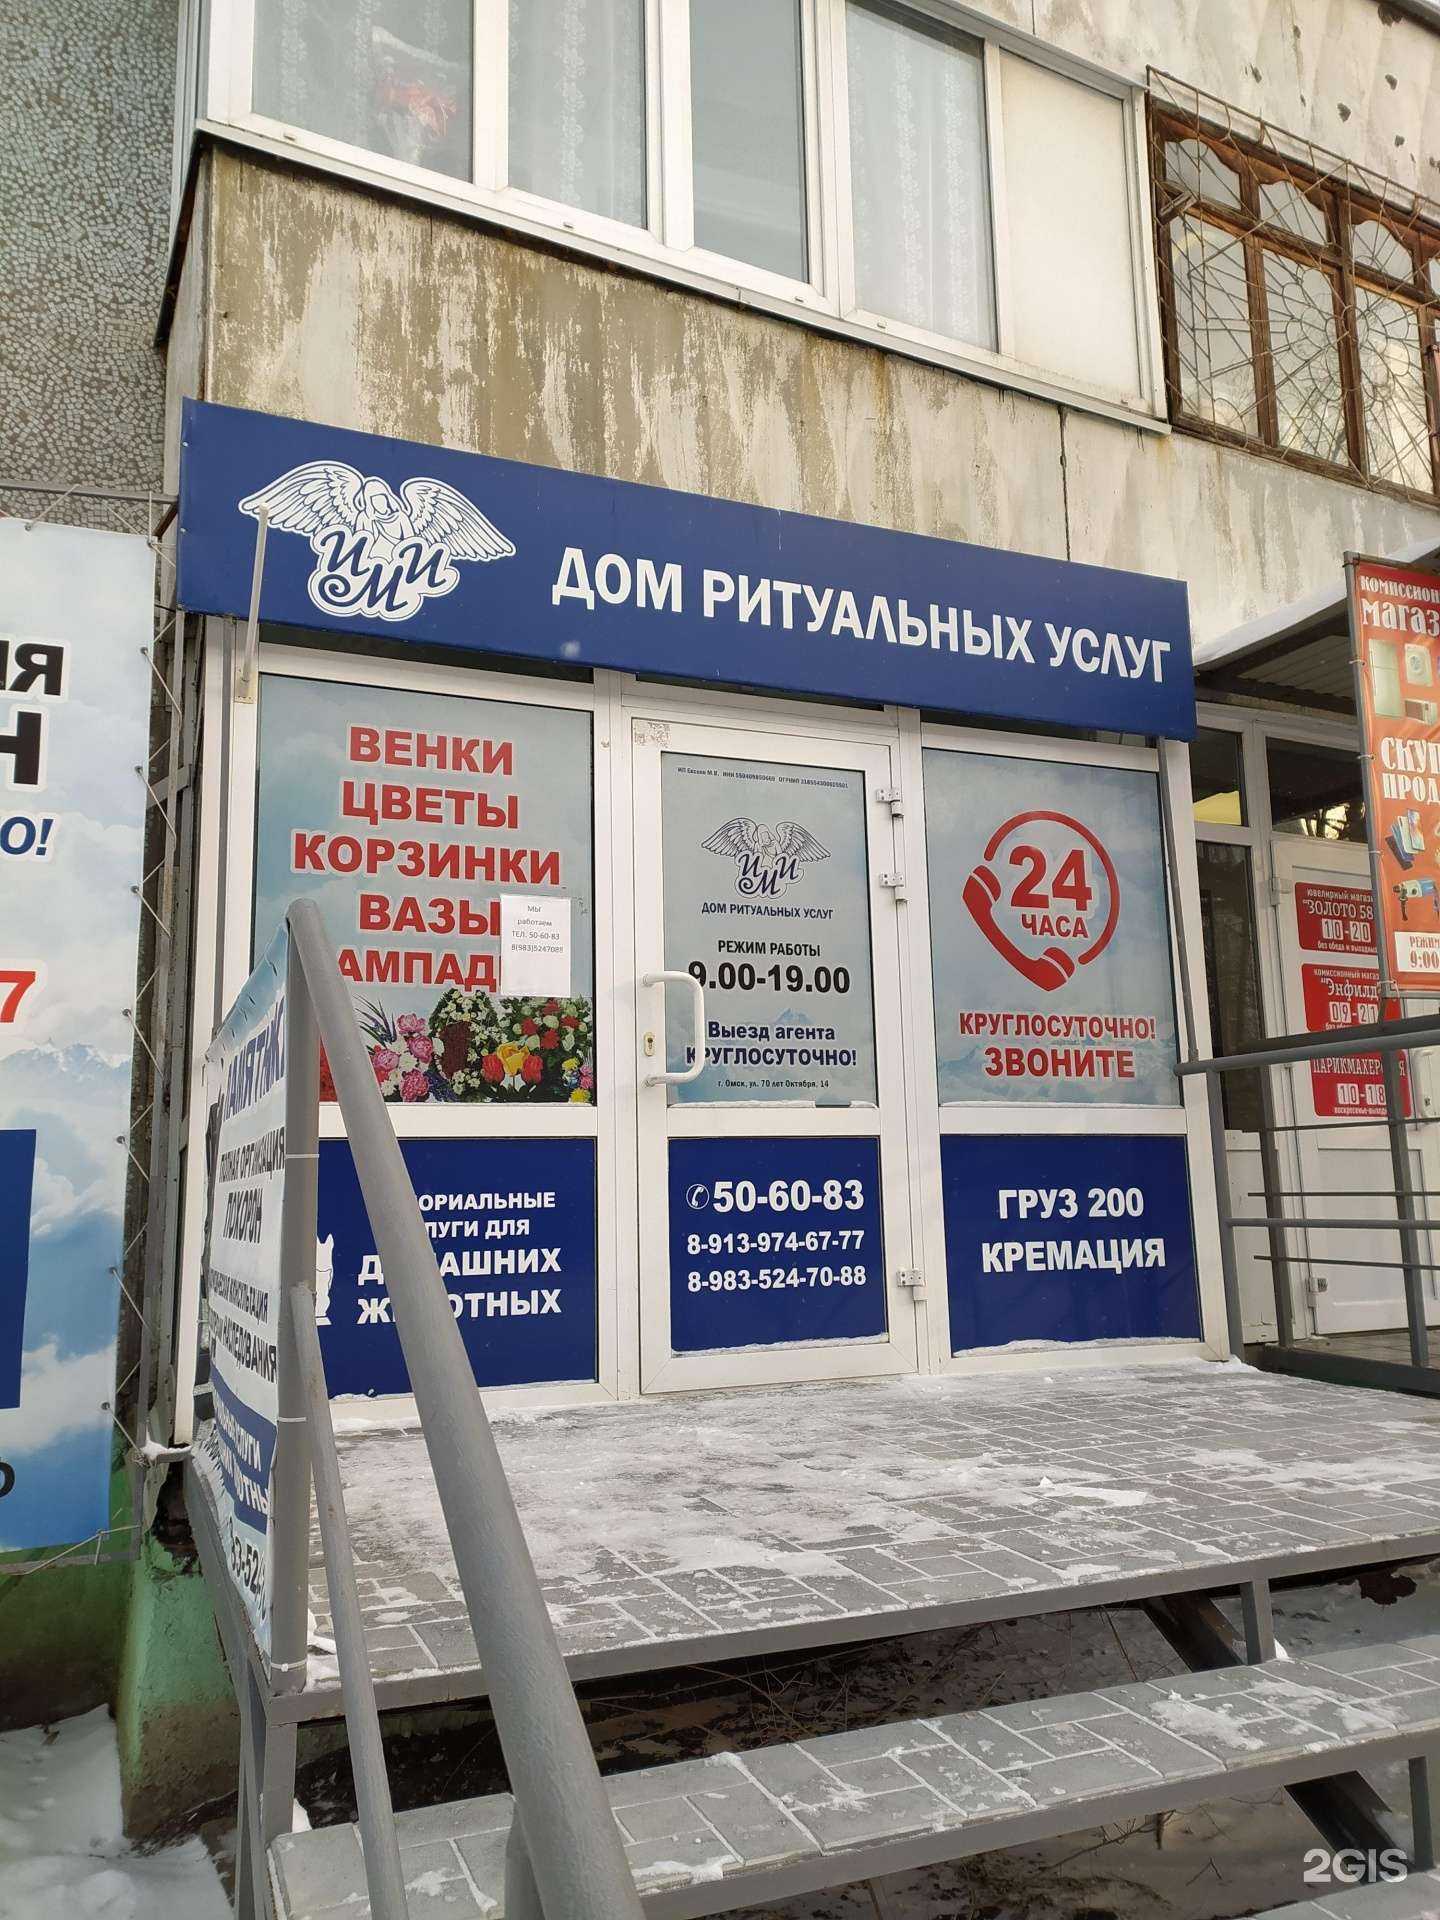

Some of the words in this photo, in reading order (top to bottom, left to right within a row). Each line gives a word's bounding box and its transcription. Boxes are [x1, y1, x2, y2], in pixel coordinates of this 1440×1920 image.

[552, 546, 683, 613] ДОМ
[703, 569, 1035, 663] РИТУАЛЬНЫХ
[1044, 623, 1171, 683] УСЛУГ
[350, 726, 513, 776] ВЕНКИ
[342, 780, 519, 829] ЦВЕТЫ
[294, 832, 560, 886] КОРЗИНКИ
[1008, 844, 1093, 912] 24
[359, 894, 501, 937] ВАЗЫ
[701, 902, 727, 915] ДОМ
[729, 903, 801, 918] РИТУАЛЬНЫХ
[803, 908, 834, 920] УСЛУГ
[1021, 913, 1089, 939] ЧАСА
[1360, 905, 1374, 920] 58
[717, 939, 767, 955] РЕЖИМ
[769, 942, 821, 957] РАБОТЫ
[338, 948, 501, 993] АМПАД
[688, 960, 851, 994] 9.00-19.00
[707, 1021, 770, 1041] Выезд
[775, 1024, 836, 1041] агента
[959, 1012, 1156, 1039] КРУГЛОСУТОЧНО!
[984, 1046, 1136, 1078] ЗВОНИТЕ
[1313, 1057, 1406, 1077] ПАРИКМАХЕРЯ
[725, 1079, 748, 1089] Омск,
[761, 1079, 771, 1088] 70
[772, 1080, 783, 1088] лет
[820, 1080, 829, 1088] 14
[416, 1191, 556, 1212] ОРИАЛЬНЫЕ
[712, 1179, 865, 1213] 50-60-83
[998, 1188, 1079, 1220] ГРУЗ
[1088, 1187, 1145, 1218] 200
[425, 1219, 480, 1239] ЛУГИ
[484, 1219, 530, 1240] ДЛЯ
[687, 1229, 866, 1256] 8-913-974-67-77
[357, 1247, 562, 1286] ДАШНИХ
[981, 1237, 1167, 1275] КРЕМАЦИЯ
[687, 1264, 867, 1293] 8-983-524-70-88
[356, 1288, 562, 1325] ЖОТНЫХ
